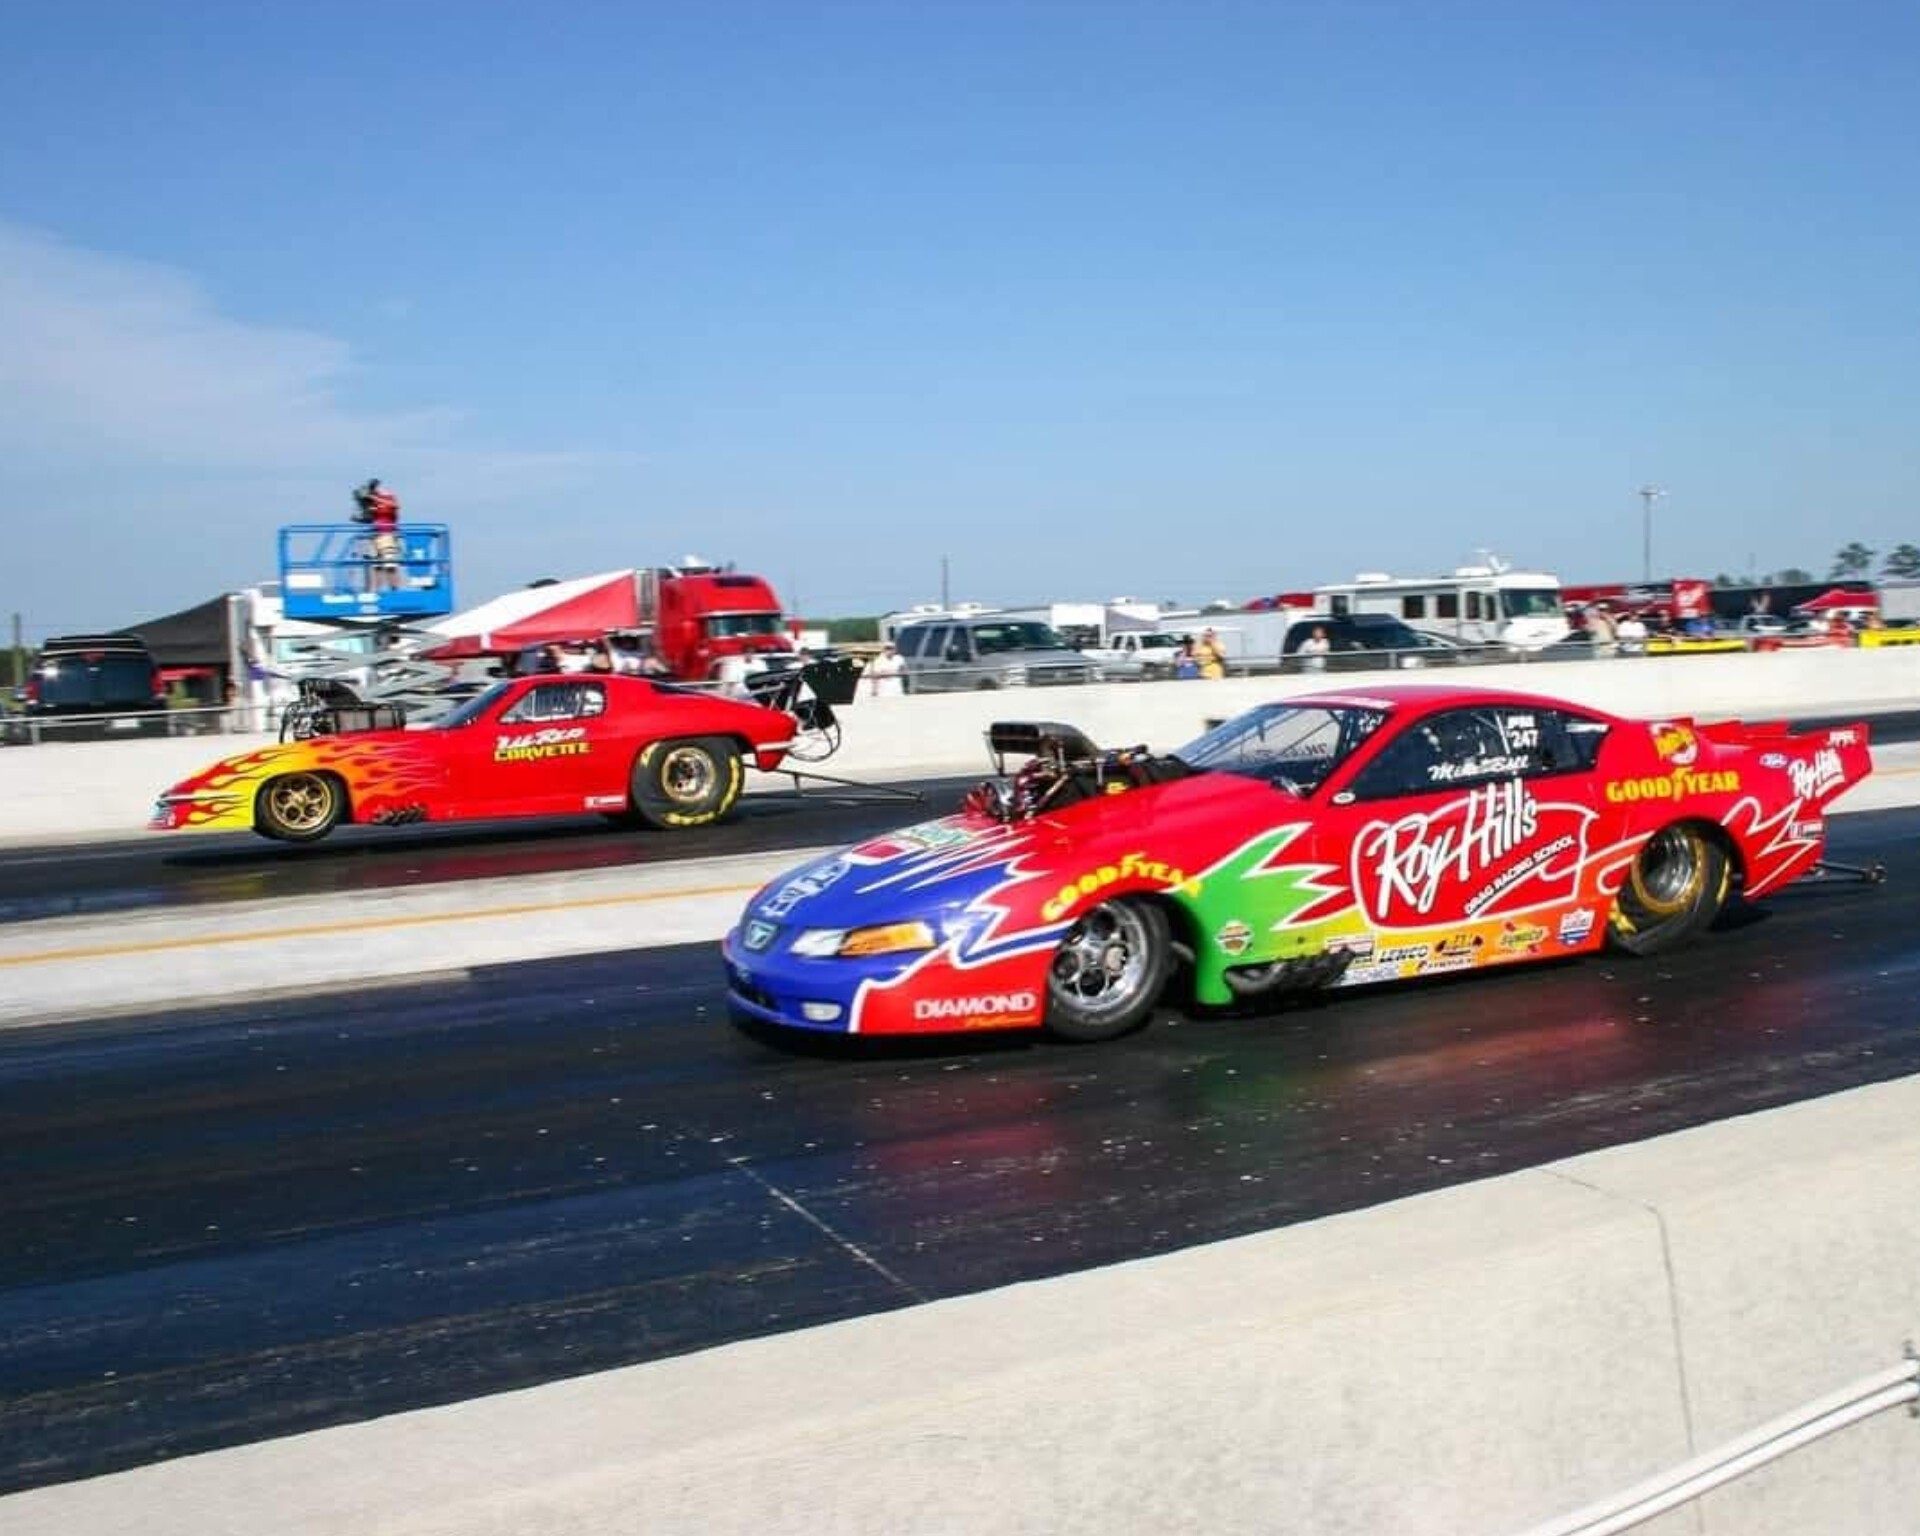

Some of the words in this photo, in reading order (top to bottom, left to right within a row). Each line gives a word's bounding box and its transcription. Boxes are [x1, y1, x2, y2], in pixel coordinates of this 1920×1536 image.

[494, 742, 592, 761] CORVETTE
[1510, 730, 1538, 748] 247
[1606, 765, 1741, 803] GOODYEAR
[1366, 813, 1456, 919] Roy
[1457, 777, 1538, 882] Hill's
[1041, 853, 1202, 922] GOODYEAR
[1464, 884, 1495, 915] DRAG
[1493, 856, 1535, 891] RACING
[1532, 835, 1577, 862] SCHOOL
[914, 992, 1036, 1020] DIAMOND
